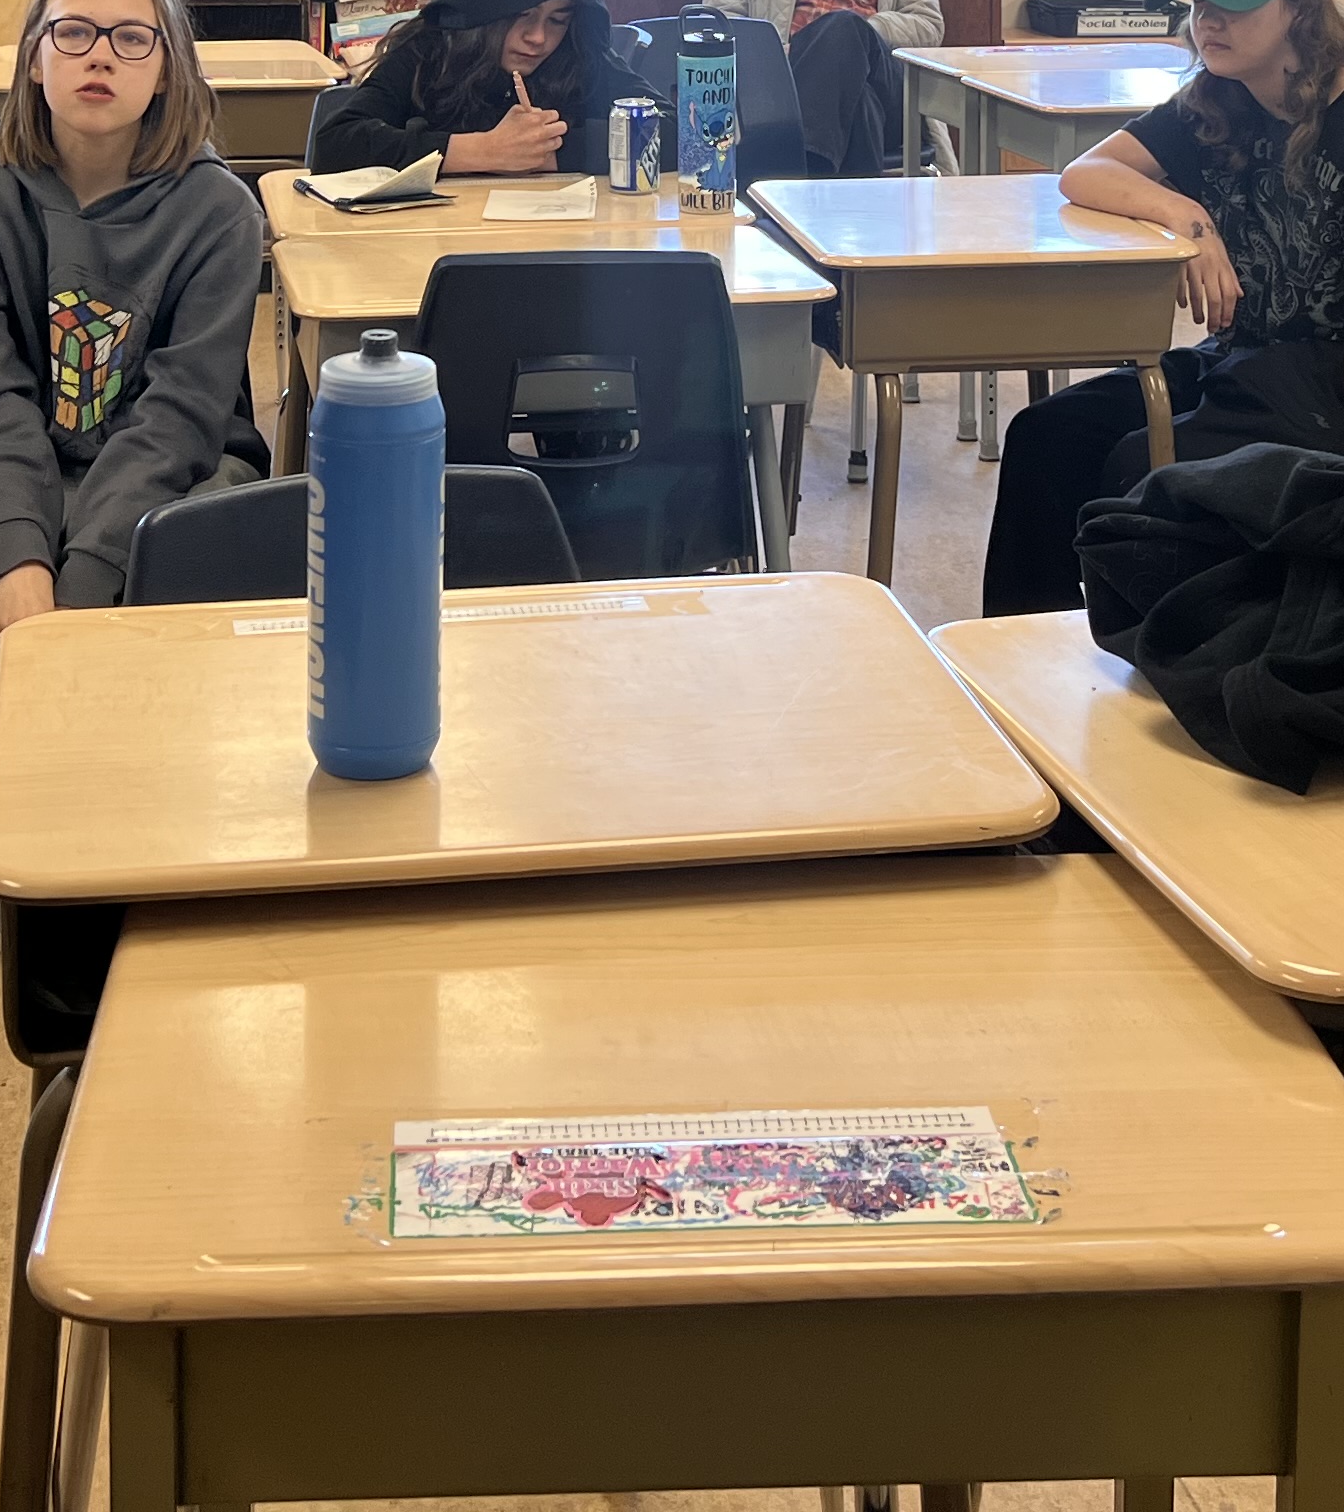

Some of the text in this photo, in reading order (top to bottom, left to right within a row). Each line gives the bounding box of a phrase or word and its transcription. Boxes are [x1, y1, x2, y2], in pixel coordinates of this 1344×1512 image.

[1079, 15, 1167, 28] Social Studies
[685, 67, 730, 87] TOUCH
[703, 87, 731, 105] AND
[681, 191, 733, 212] WILL BIT
